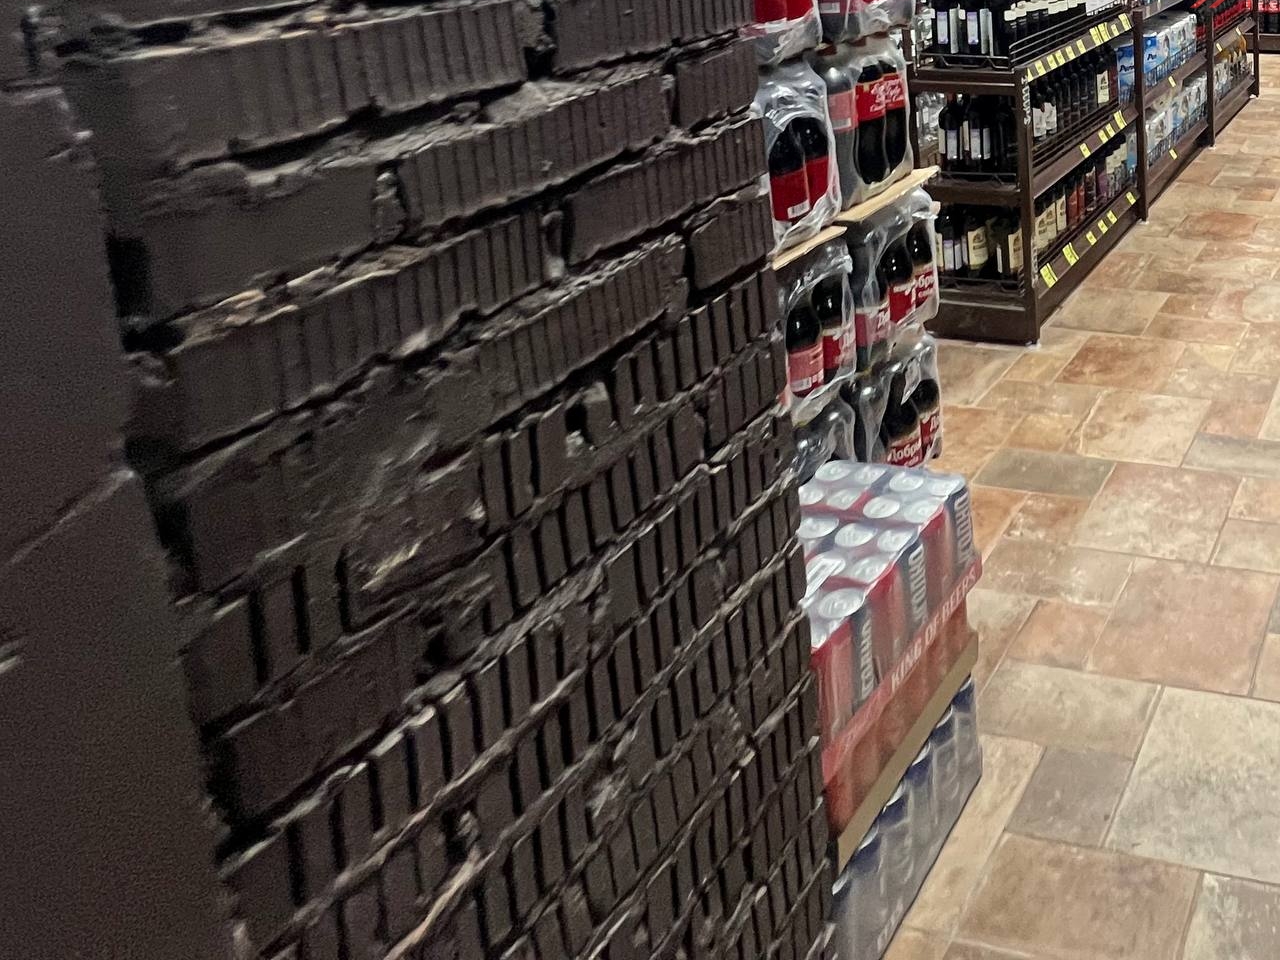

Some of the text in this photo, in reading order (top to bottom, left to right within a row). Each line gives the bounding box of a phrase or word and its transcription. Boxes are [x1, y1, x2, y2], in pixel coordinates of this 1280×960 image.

[890, 638, 922, 693] KING
[924, 614, 940, 645] OF
[941, 567, 977, 624] BEERS
